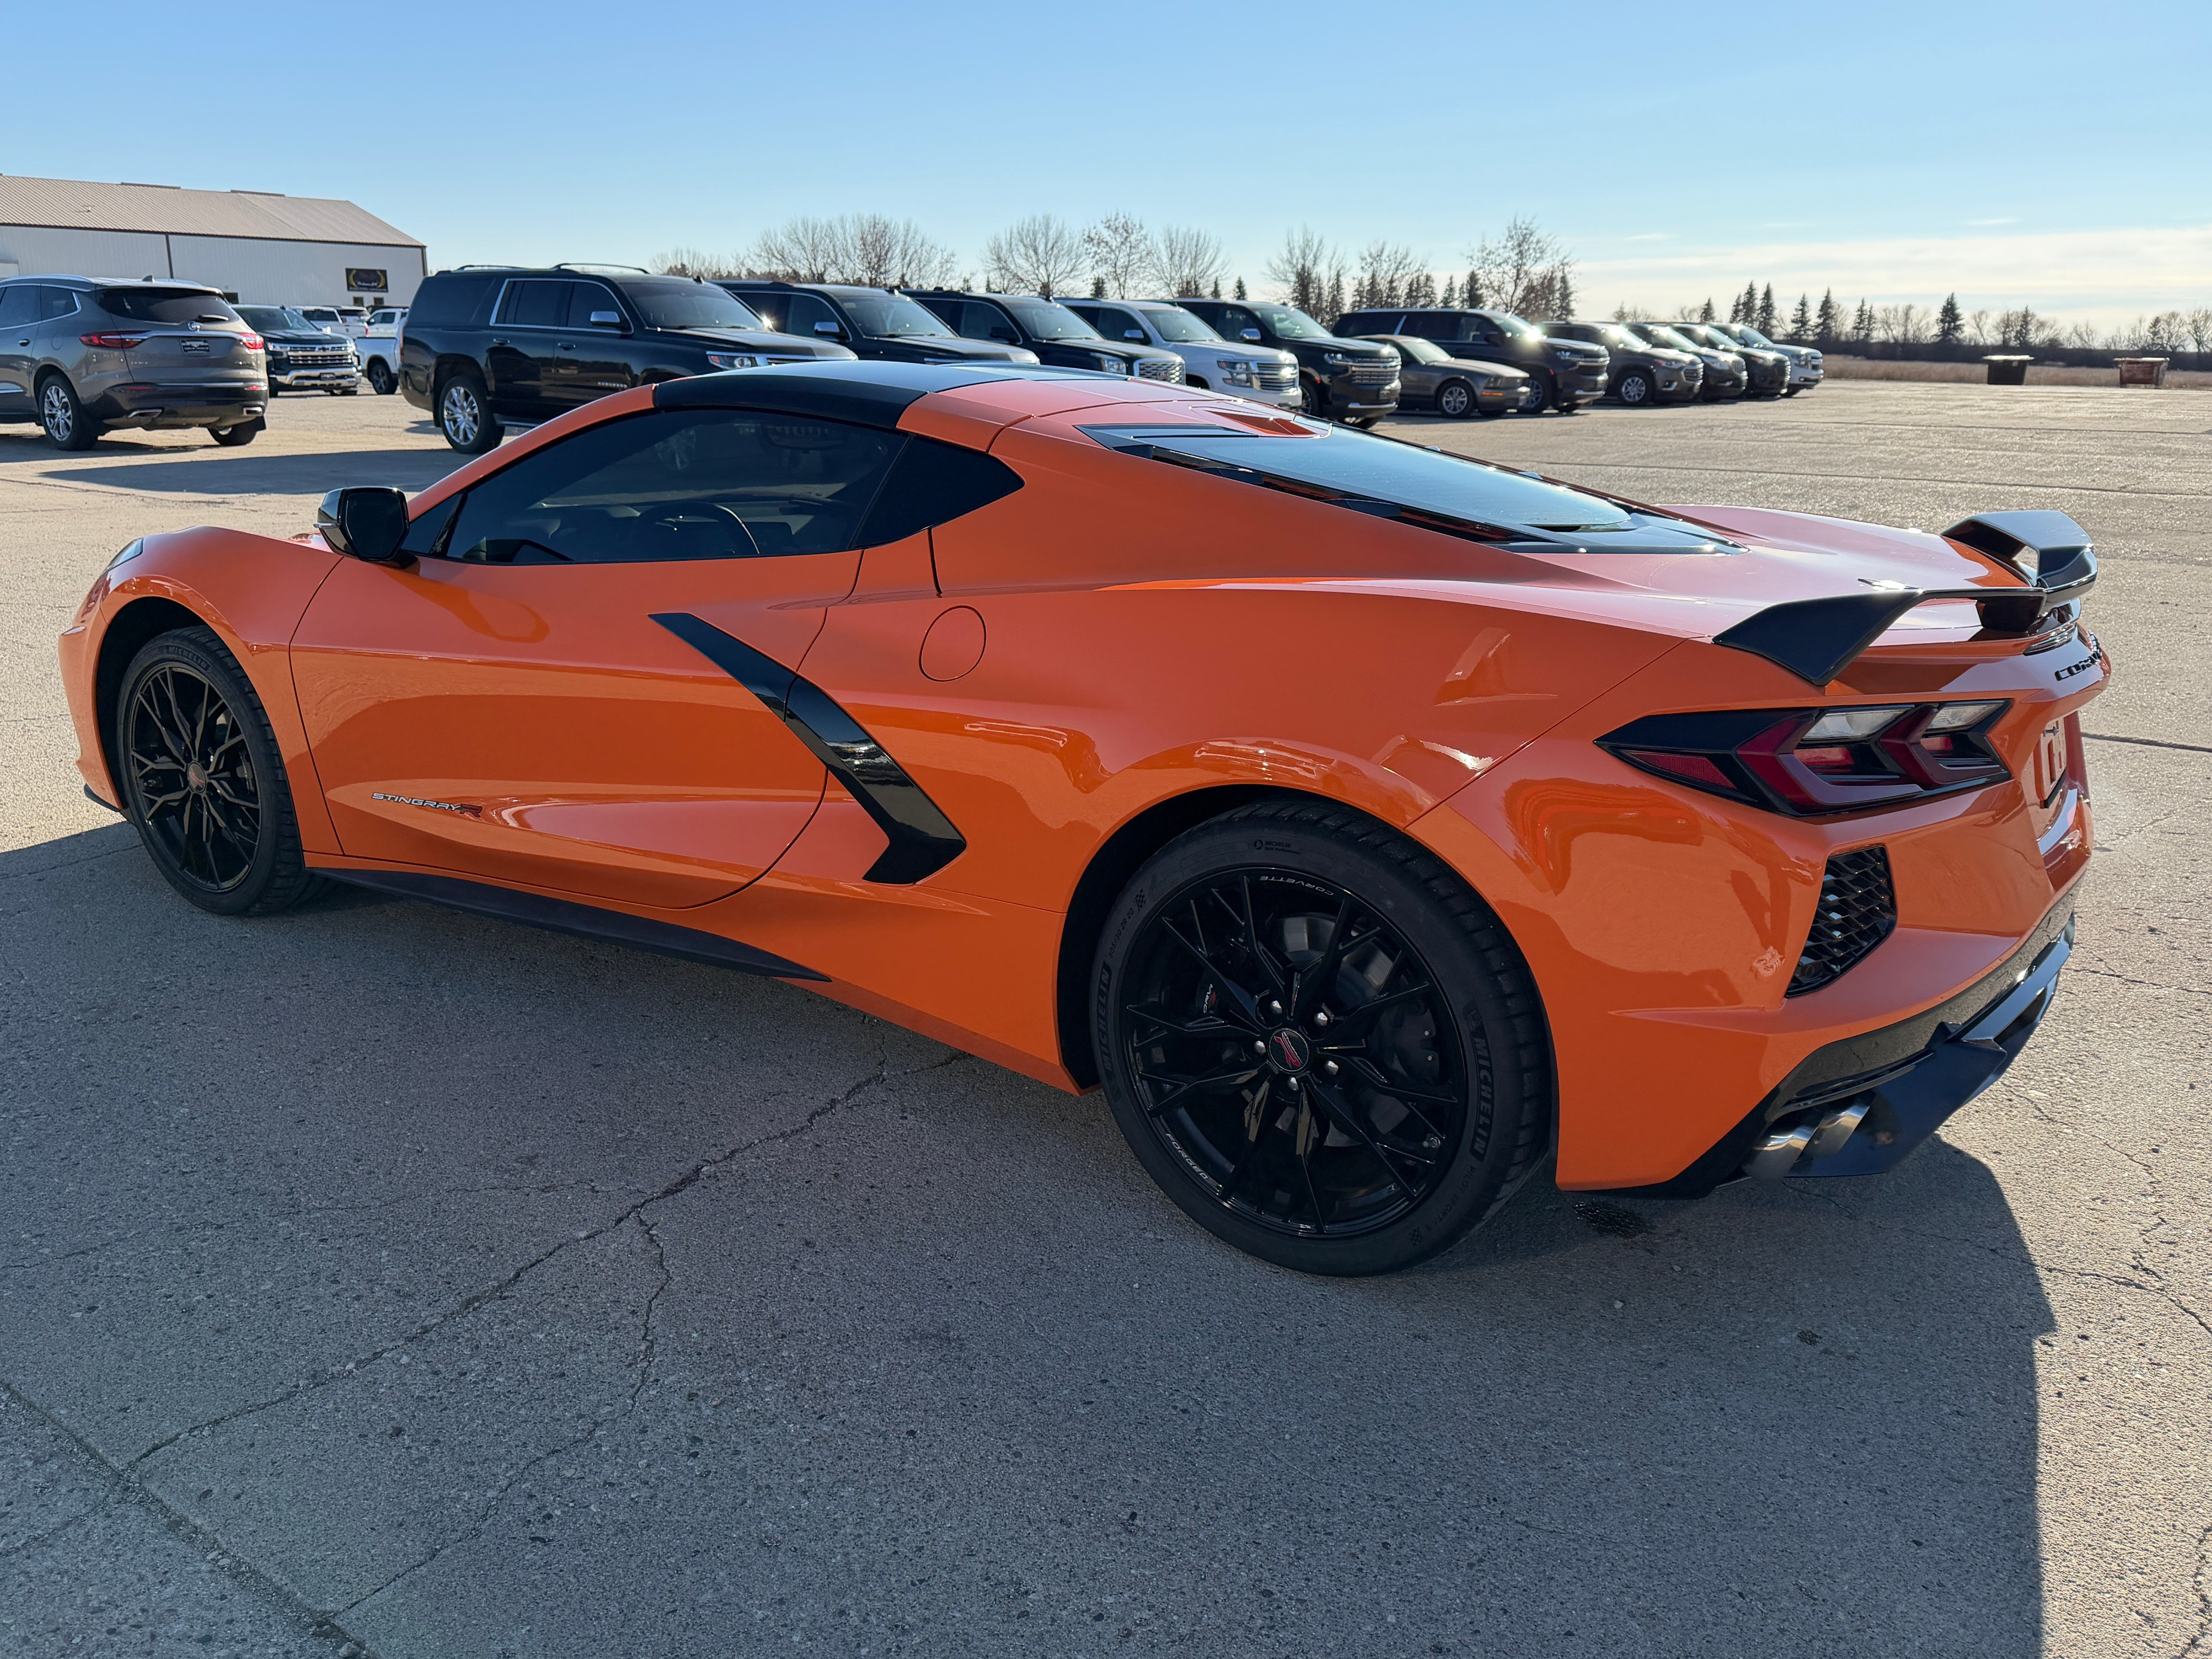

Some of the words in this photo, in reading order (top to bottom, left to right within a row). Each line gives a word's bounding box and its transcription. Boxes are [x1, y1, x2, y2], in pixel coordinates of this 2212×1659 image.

[168, 646, 207, 669] MICHELIN
[372, 792, 460, 811] STINGRAY
[1259, 876, 1334, 896] CORVETTE
[1098, 968, 1113, 1072] MICHELIN
[1473, 1037, 1494, 1155] MICHELIN
[1166, 1133, 1209, 1180] FORGED
